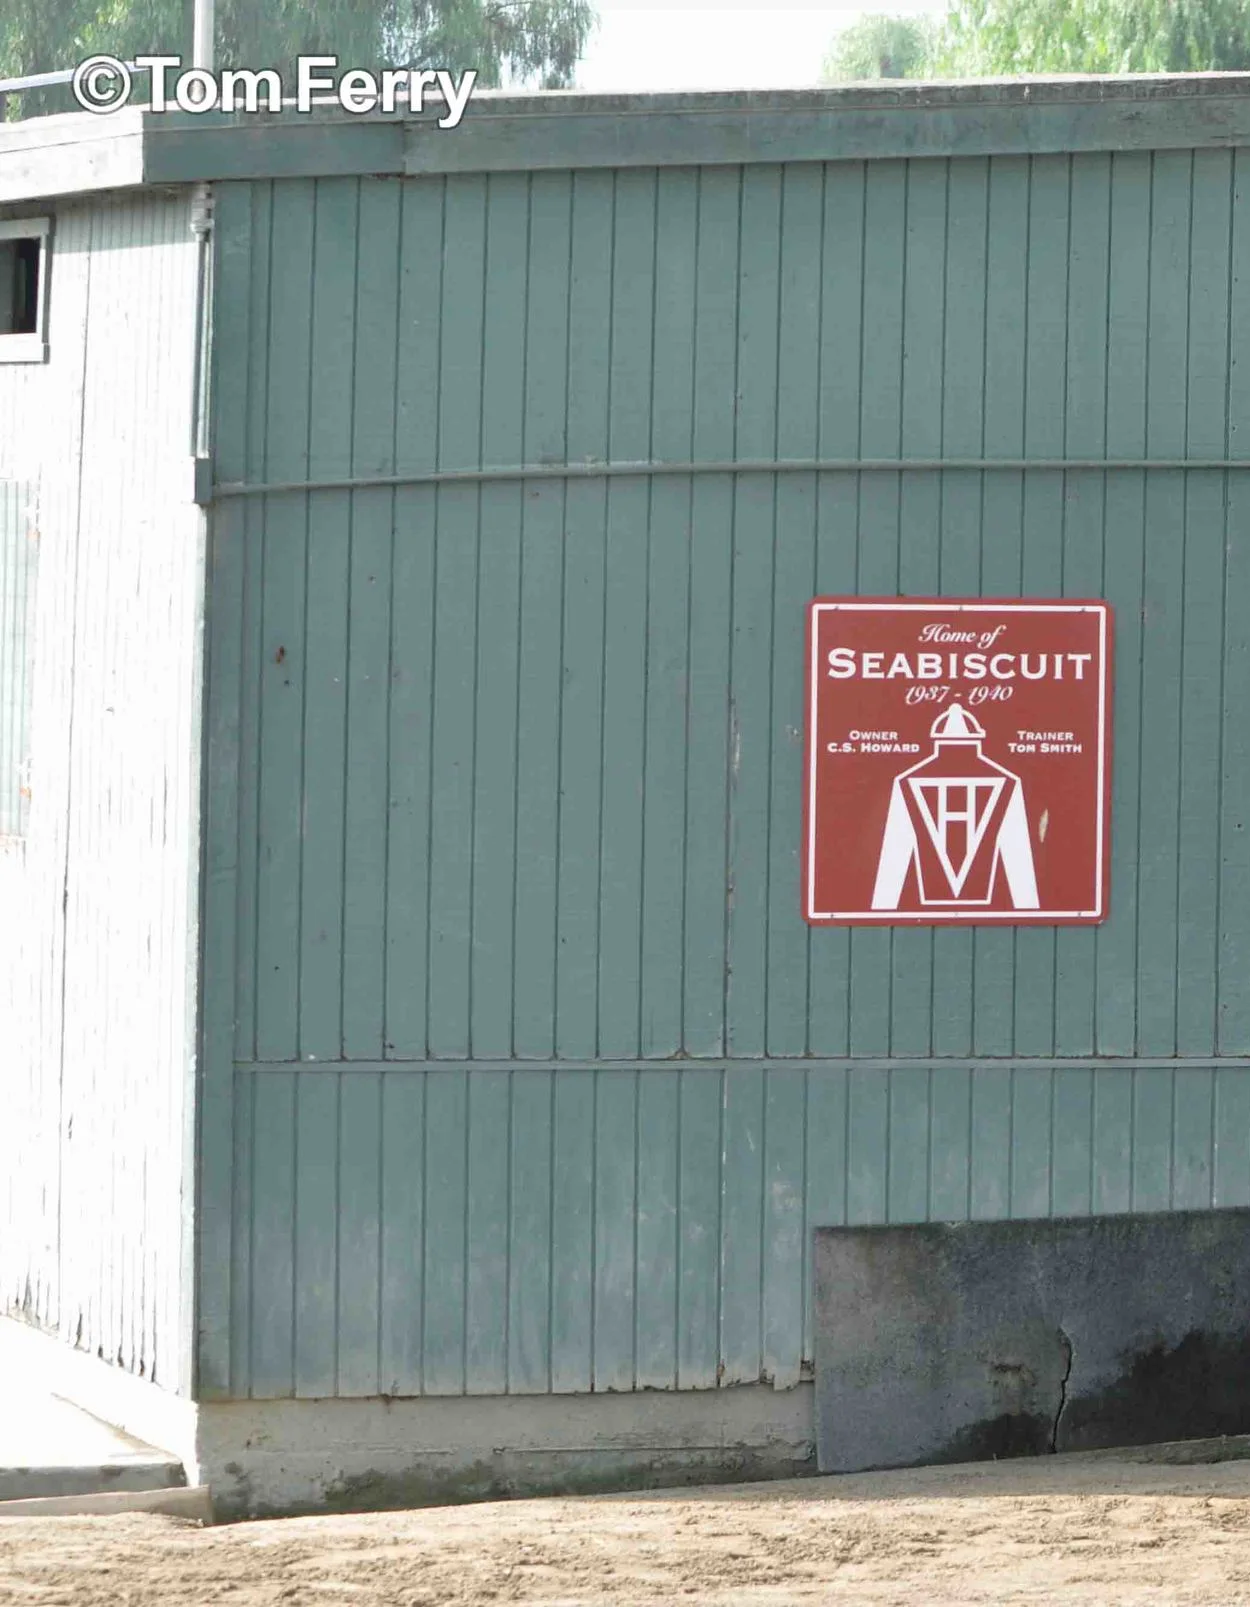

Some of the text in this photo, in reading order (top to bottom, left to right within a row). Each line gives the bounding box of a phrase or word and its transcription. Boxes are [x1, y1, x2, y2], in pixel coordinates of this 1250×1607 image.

[918, 623, 1007, 649] Home of
[828, 648, 1092, 680] SEABISCUIT
[905, 685, 950, 705] 1937
[968, 685, 1014, 706] 1940
[849, 730, 898, 741] OWNER
[1016, 730, 1074, 741] TRAINER
[827, 743, 920, 753] C.S. HOWARD
[1008, 743, 1082, 753] TOM SMITH
